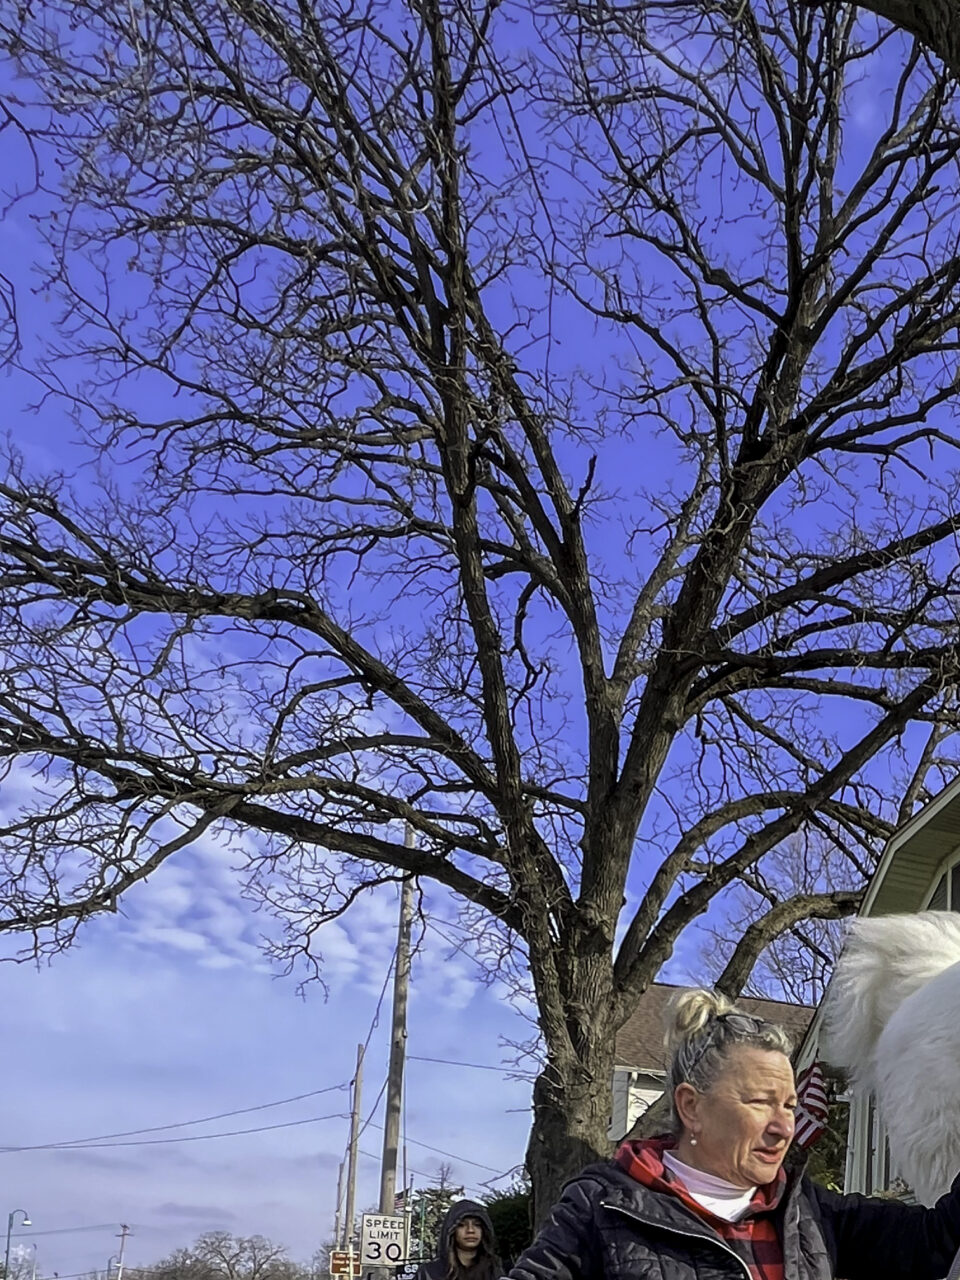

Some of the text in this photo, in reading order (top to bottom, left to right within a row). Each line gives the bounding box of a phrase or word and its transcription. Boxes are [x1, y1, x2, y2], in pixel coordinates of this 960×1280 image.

[366, 1219, 405, 1230] SPEED
[369, 1230, 401, 1240] LIMIT
[366, 1242, 402, 1260] 30
